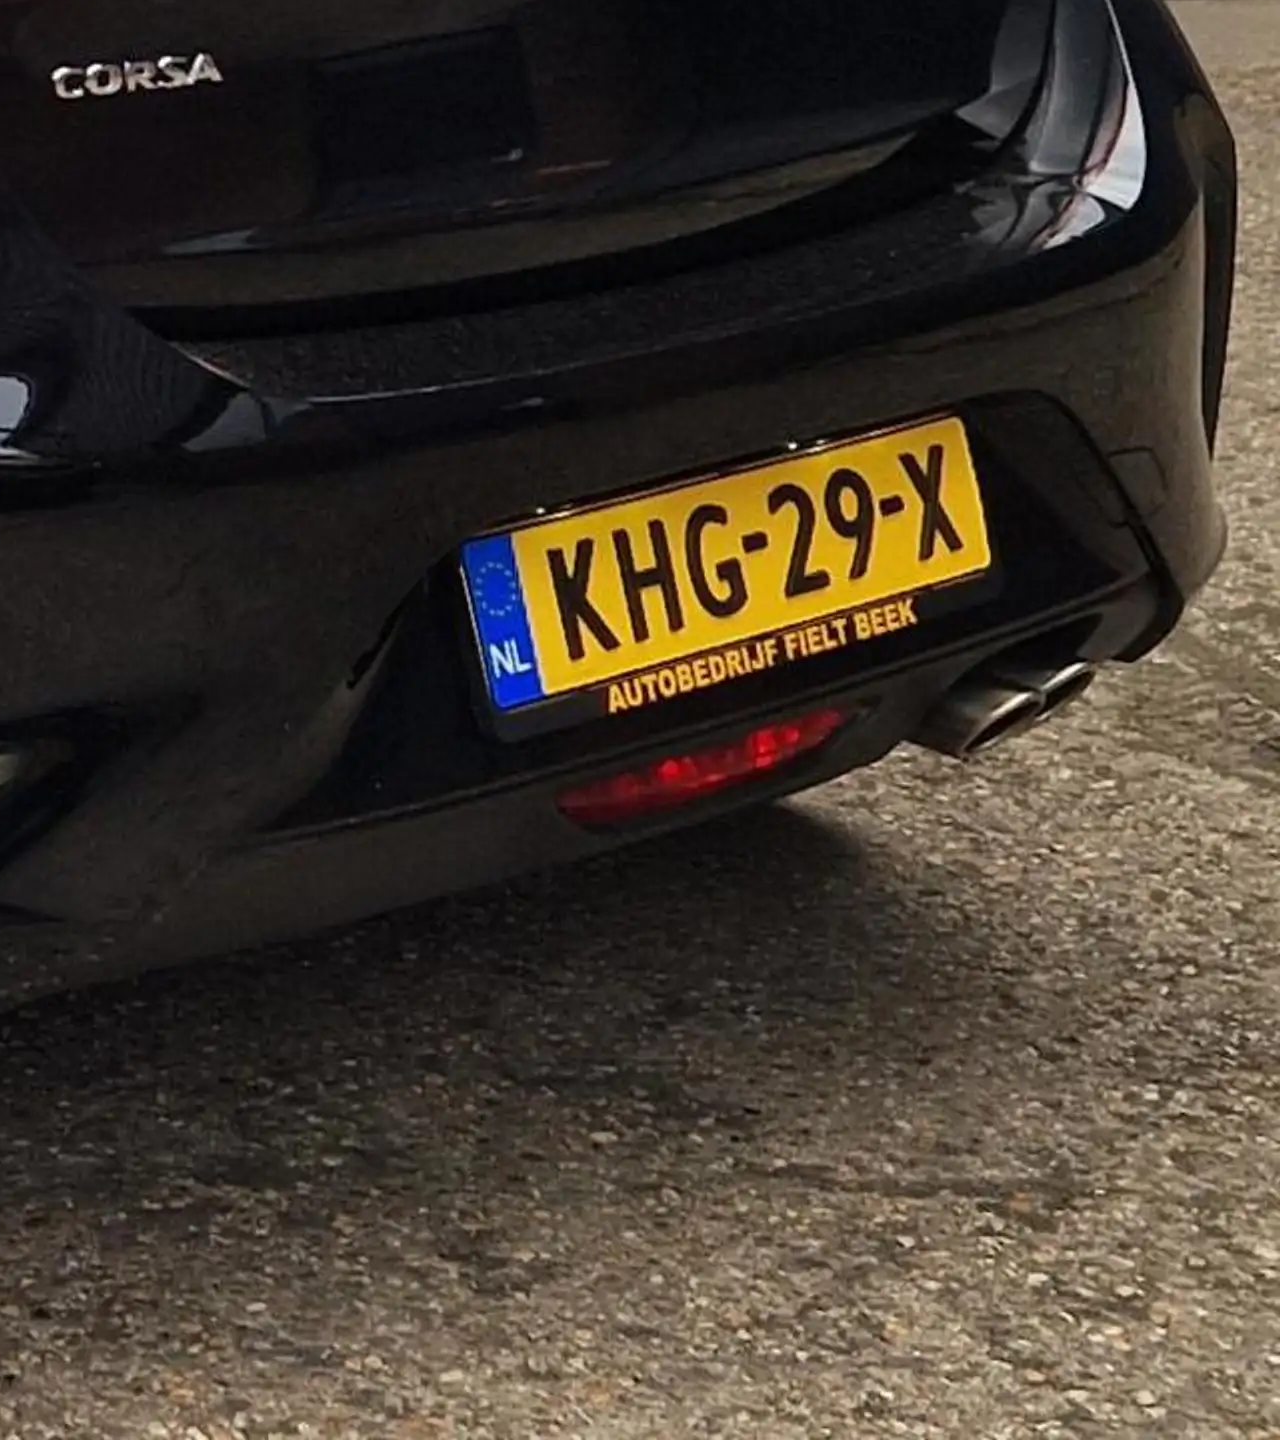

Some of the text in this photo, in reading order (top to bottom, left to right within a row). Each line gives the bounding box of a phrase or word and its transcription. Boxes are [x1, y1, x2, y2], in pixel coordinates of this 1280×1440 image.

[50, 52, 224, 100] CORSA
[546, 444, 964, 660] KHG-29-X
[488, 639, 532, 679] NL
[607, 597, 918, 713] AUTOBEDRIJF FIELT BEEK
